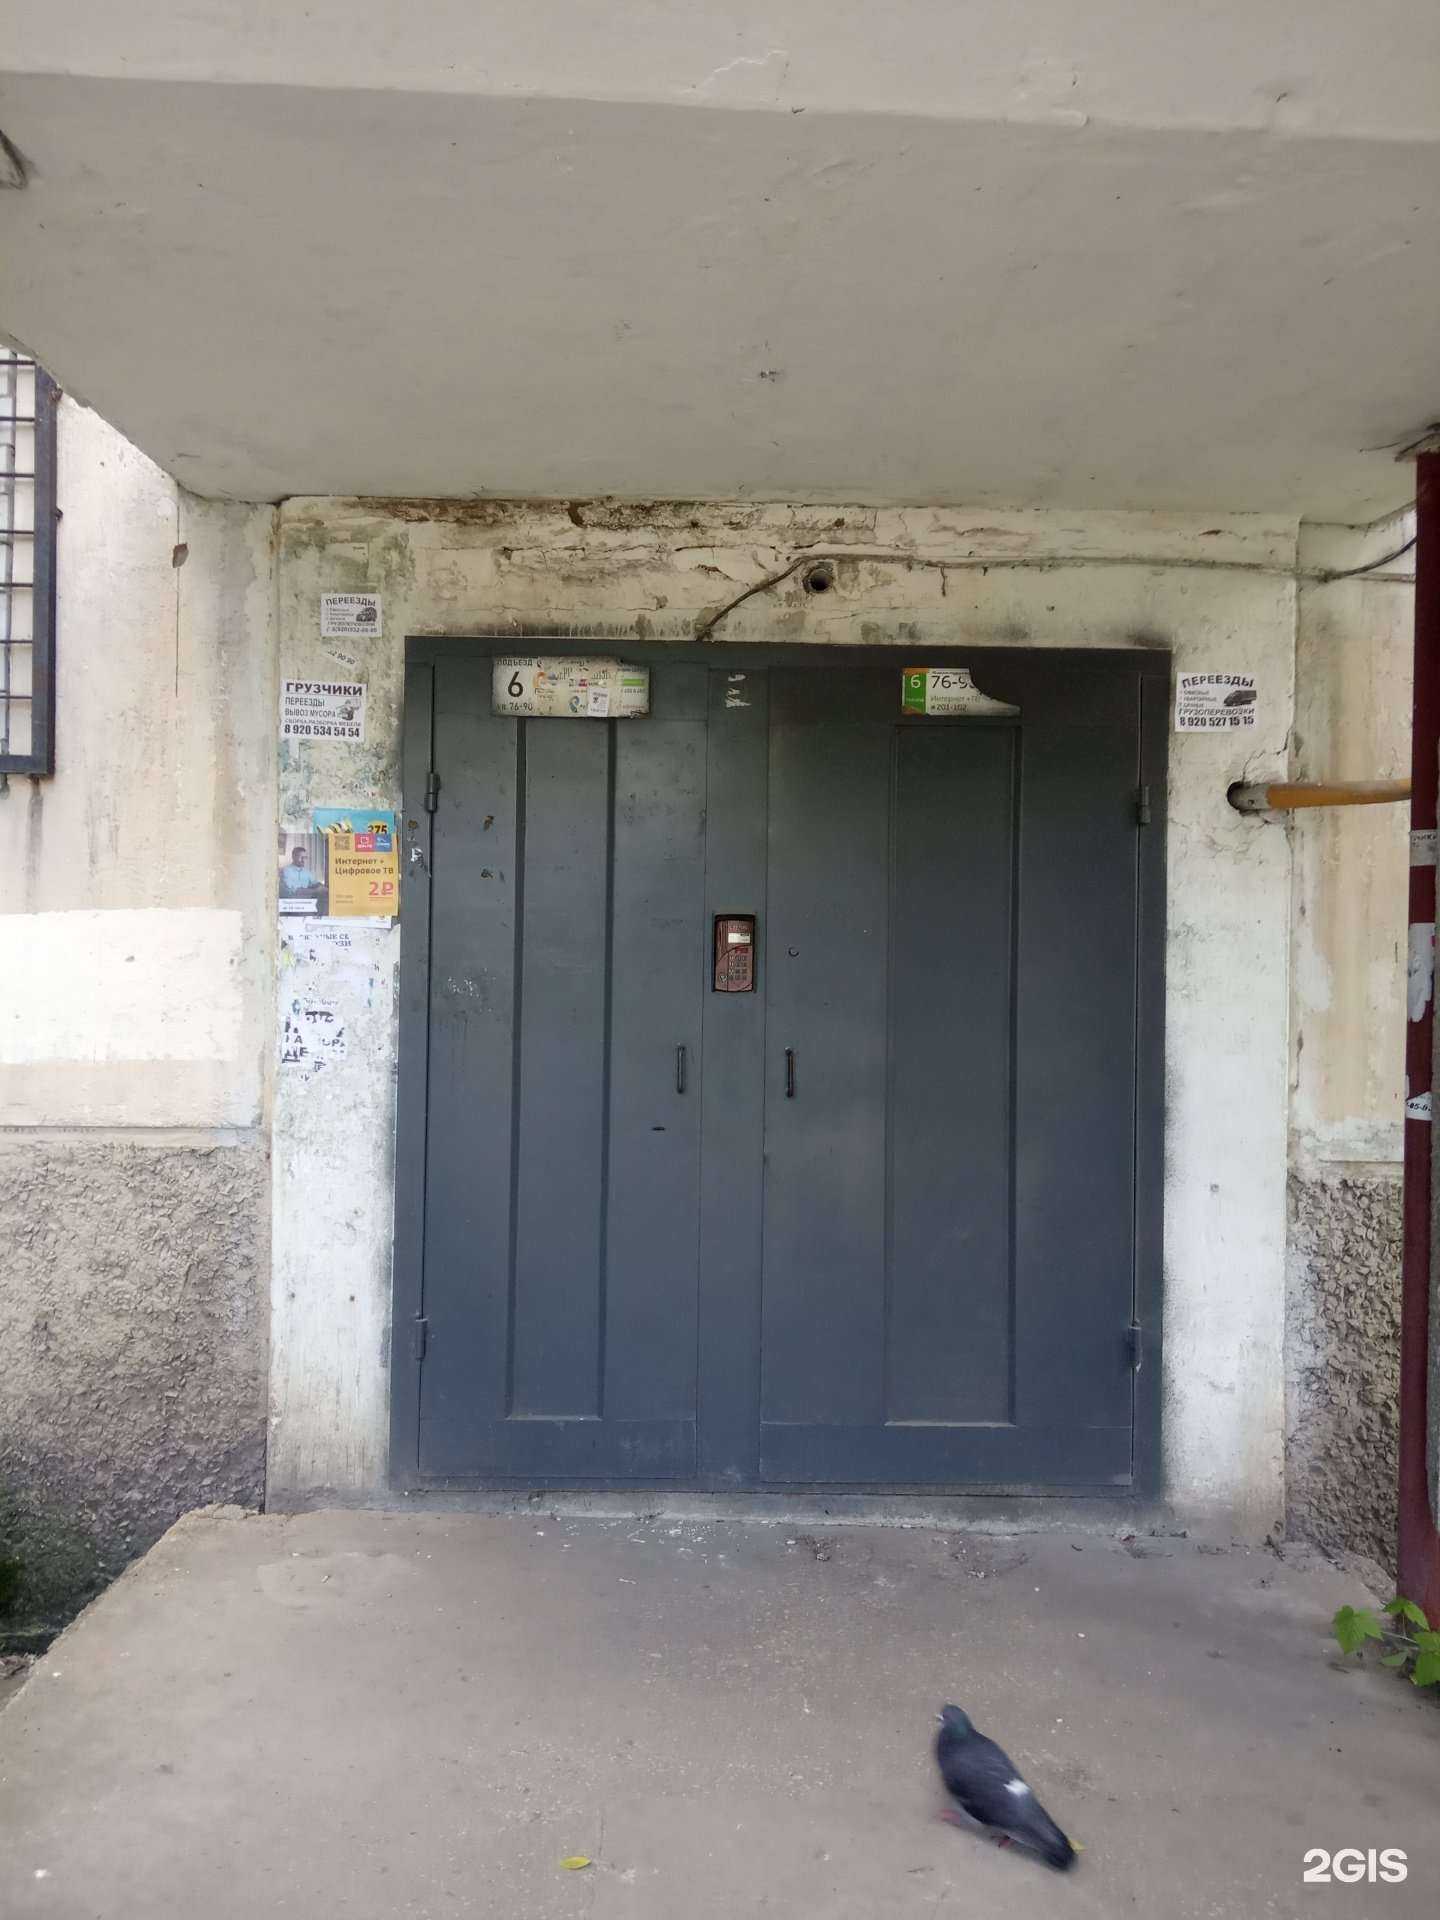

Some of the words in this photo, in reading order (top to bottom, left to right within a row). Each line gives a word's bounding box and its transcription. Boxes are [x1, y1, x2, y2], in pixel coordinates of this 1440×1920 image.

[325, 596, 376, 607] ПЕРЕЕЗДЫ
[507, 671, 524, 698] 6
[910, 674, 921, 689] 6
[1182, 674, 1254, 688] ПЕРЕЕЗДЫ
[286, 682, 363, 696] ГРУЗЧИКИ
[285, 697, 325, 707] ПЕРЕЕЗДЫ
[285, 708, 309, 717] ВЫВОЗ
[309, 710, 336, 718] МУСОРА
[1187, 716, 1207, 727] 920
[1209, 716, 1227, 727] 527
[284, 723, 291, 734] 8
[292, 724, 311, 735] 920
[313, 725, 332, 736] 534
[334, 726, 346, 737] 54
[348, 727, 360, 738] 54
[335, 857, 377, 866] Интернет
[335, 867, 381, 876] Цифровое
[383, 867, 394, 875] ТВ
